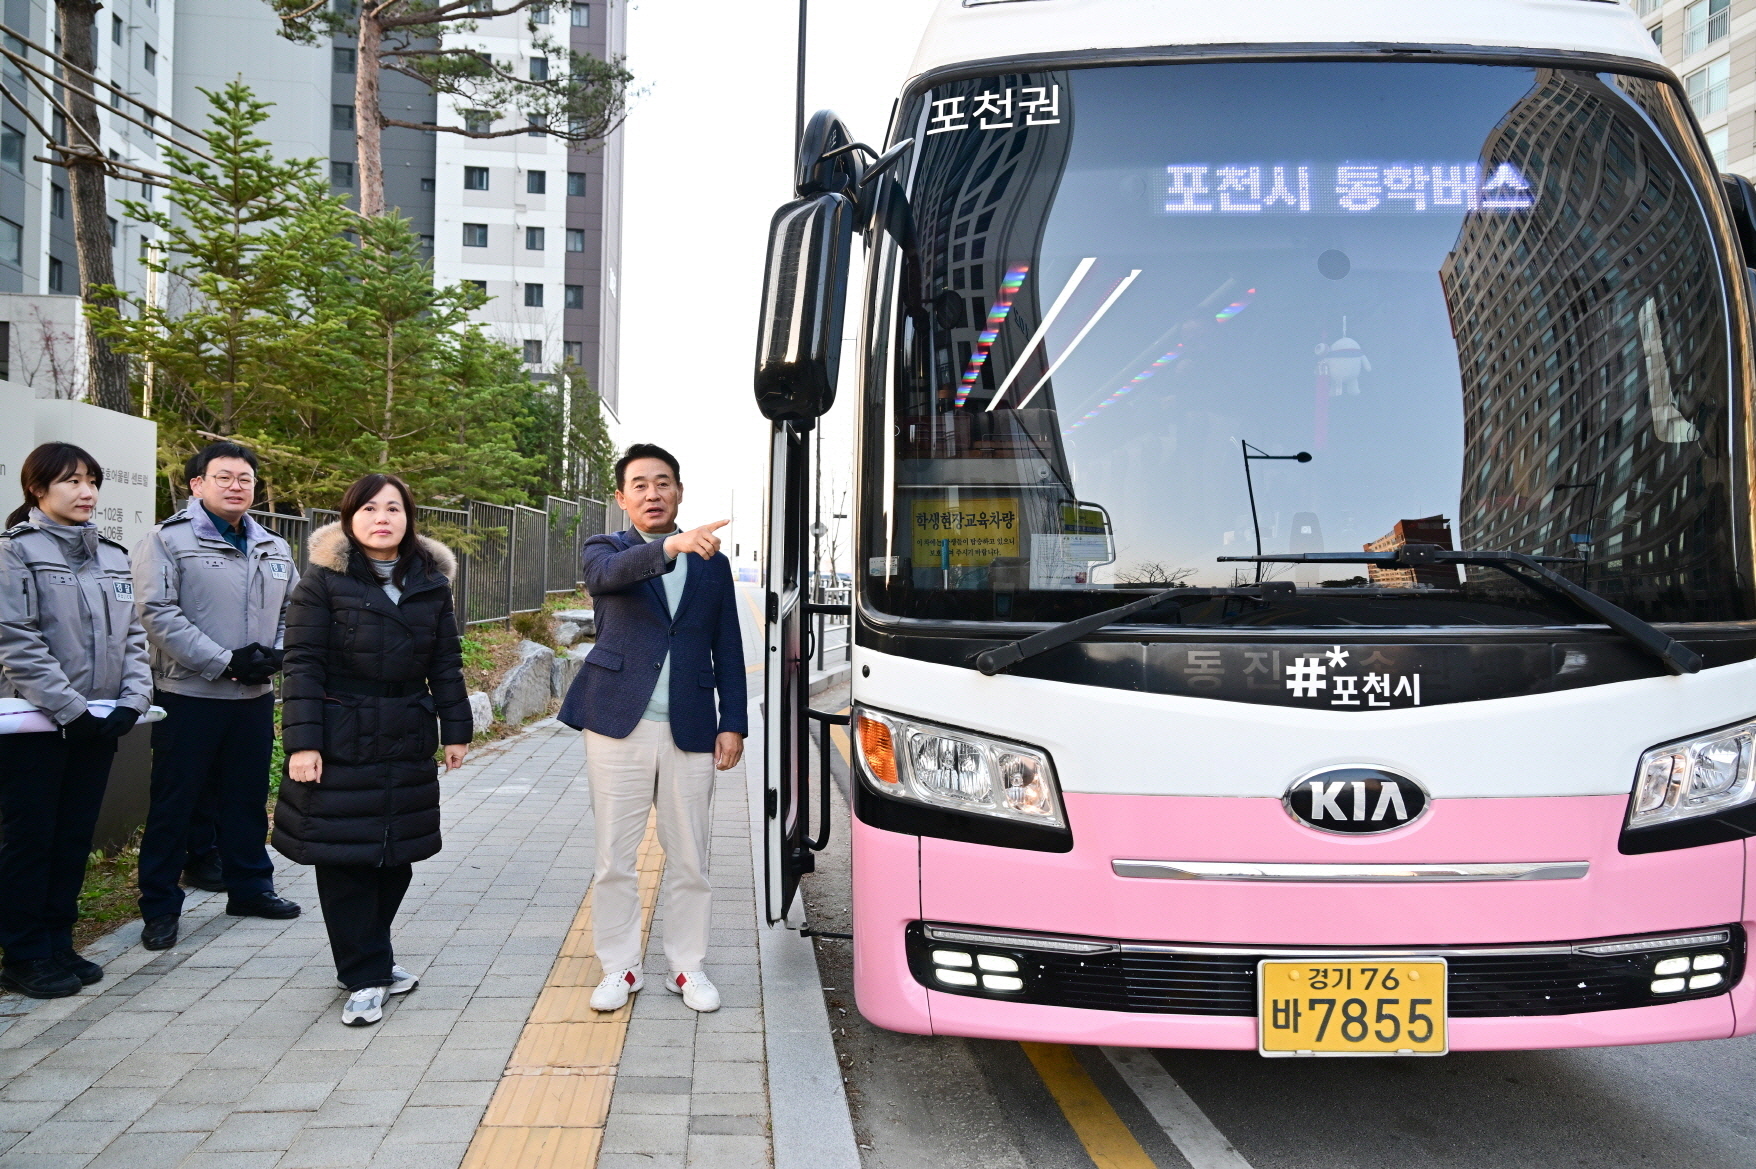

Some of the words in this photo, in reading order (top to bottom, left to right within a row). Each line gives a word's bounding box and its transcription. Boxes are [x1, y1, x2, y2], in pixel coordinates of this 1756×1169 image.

[926, 84, 1061, 136] 포천권
[1165, 165, 1311, 212] 포천시
[1335, 163, 1531, 212] 통학버스
[90, 507, 123, 523] 1-102동
[915, 510, 1016, 531] 학생현장교육차량
[98, 526, 123, 541] -106동
[946, 537, 969, 546] 생들이
[929, 548, 954, 557] 보호여
[955, 548, 974, 557] 주시기
[1330, 672, 1421, 707] 포천시
[1309, 780, 1408, 822] KIA
